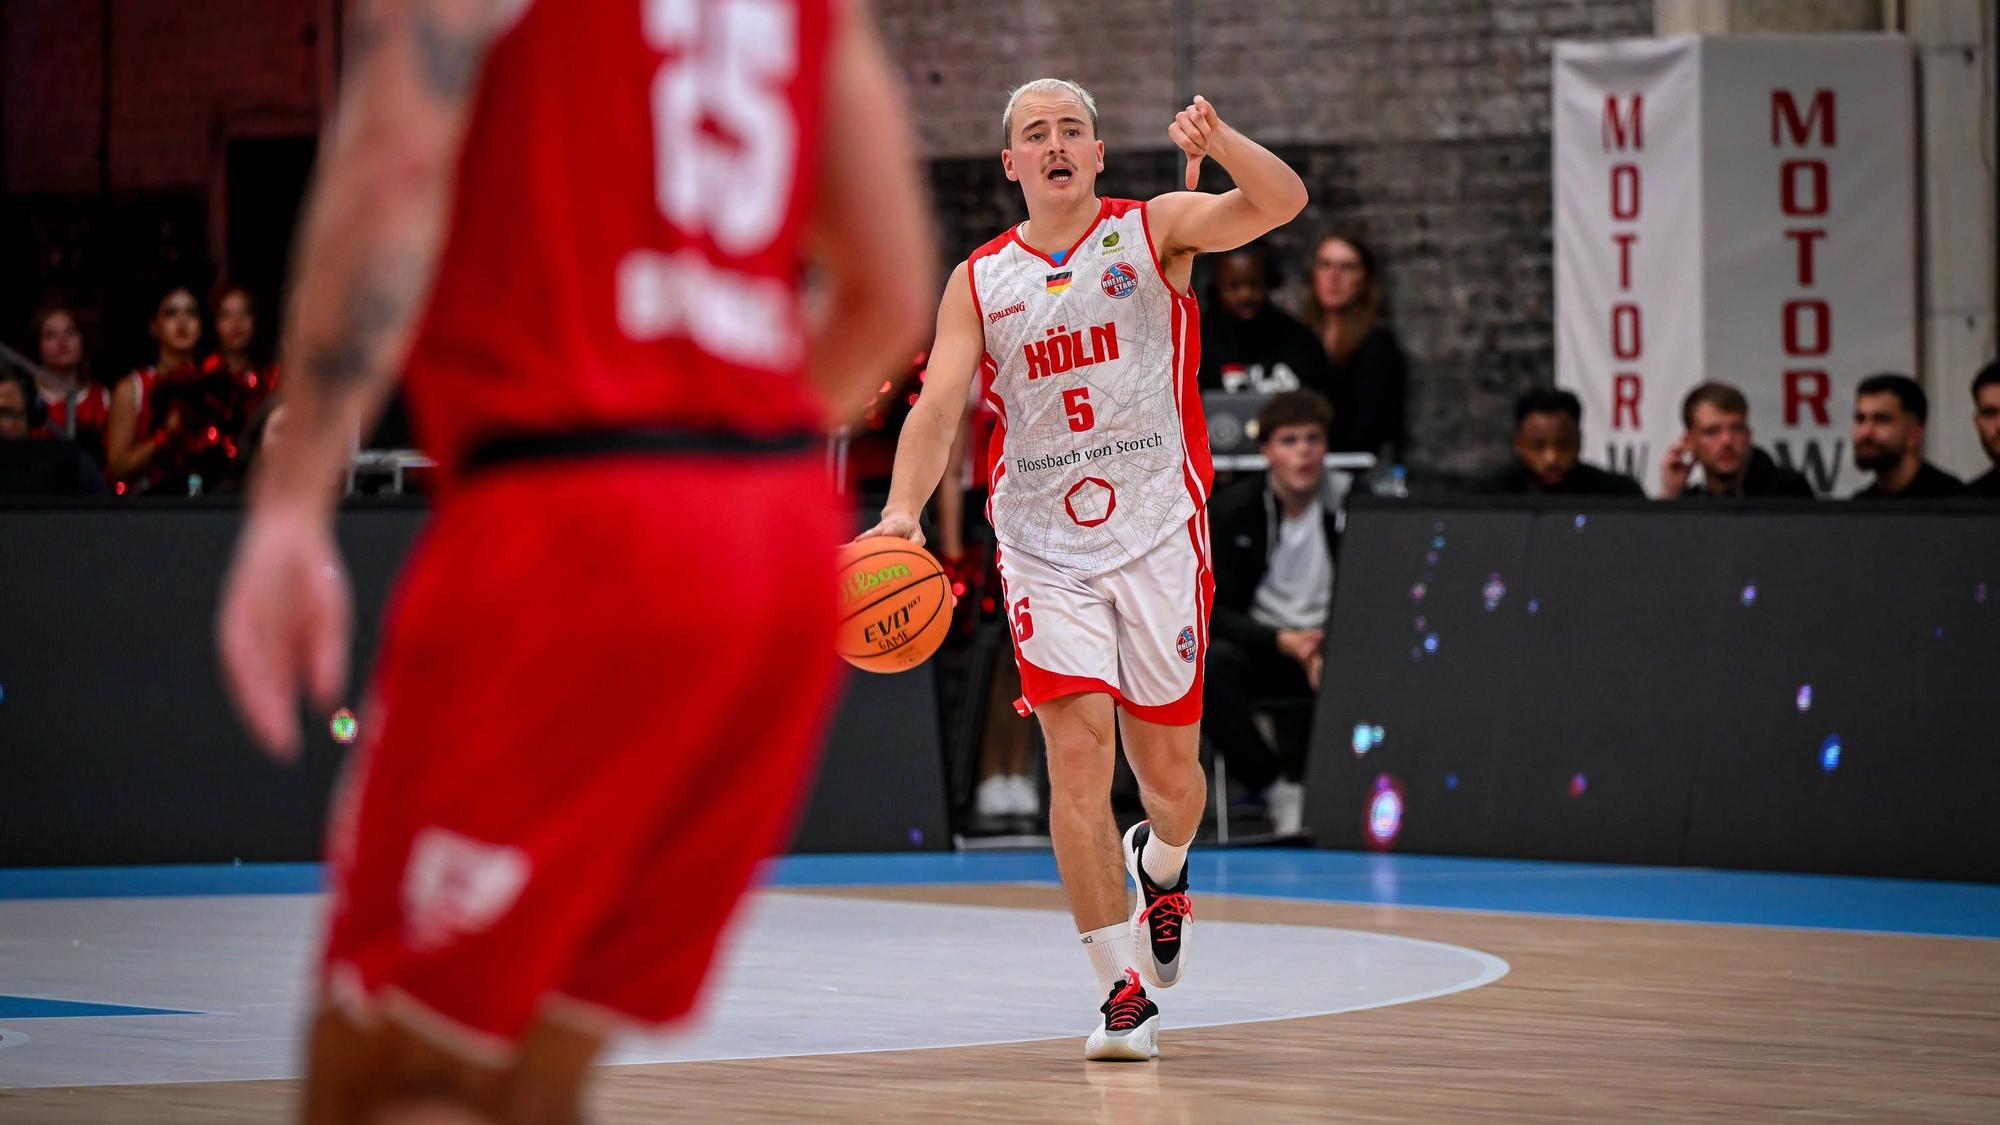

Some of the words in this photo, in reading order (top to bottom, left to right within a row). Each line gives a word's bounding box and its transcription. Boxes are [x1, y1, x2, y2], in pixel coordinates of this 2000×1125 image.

[1102, 276, 1124, 288] RHEIN
[1114, 279, 1137, 292] STARS
[988, 301, 1026, 324] SPALDING
[1023, 322, 1120, 380] KÖLN
[1062, 387, 1095, 432] 5
[1017, 449, 1081, 473] Flossbach
[1084, 444, 1113, 461] von
[1116, 432, 1163, 454] Storch
[864, 608, 910, 644] EVO
[1013, 596, 1034, 643] 5
[878, 629, 909, 651] GAME
